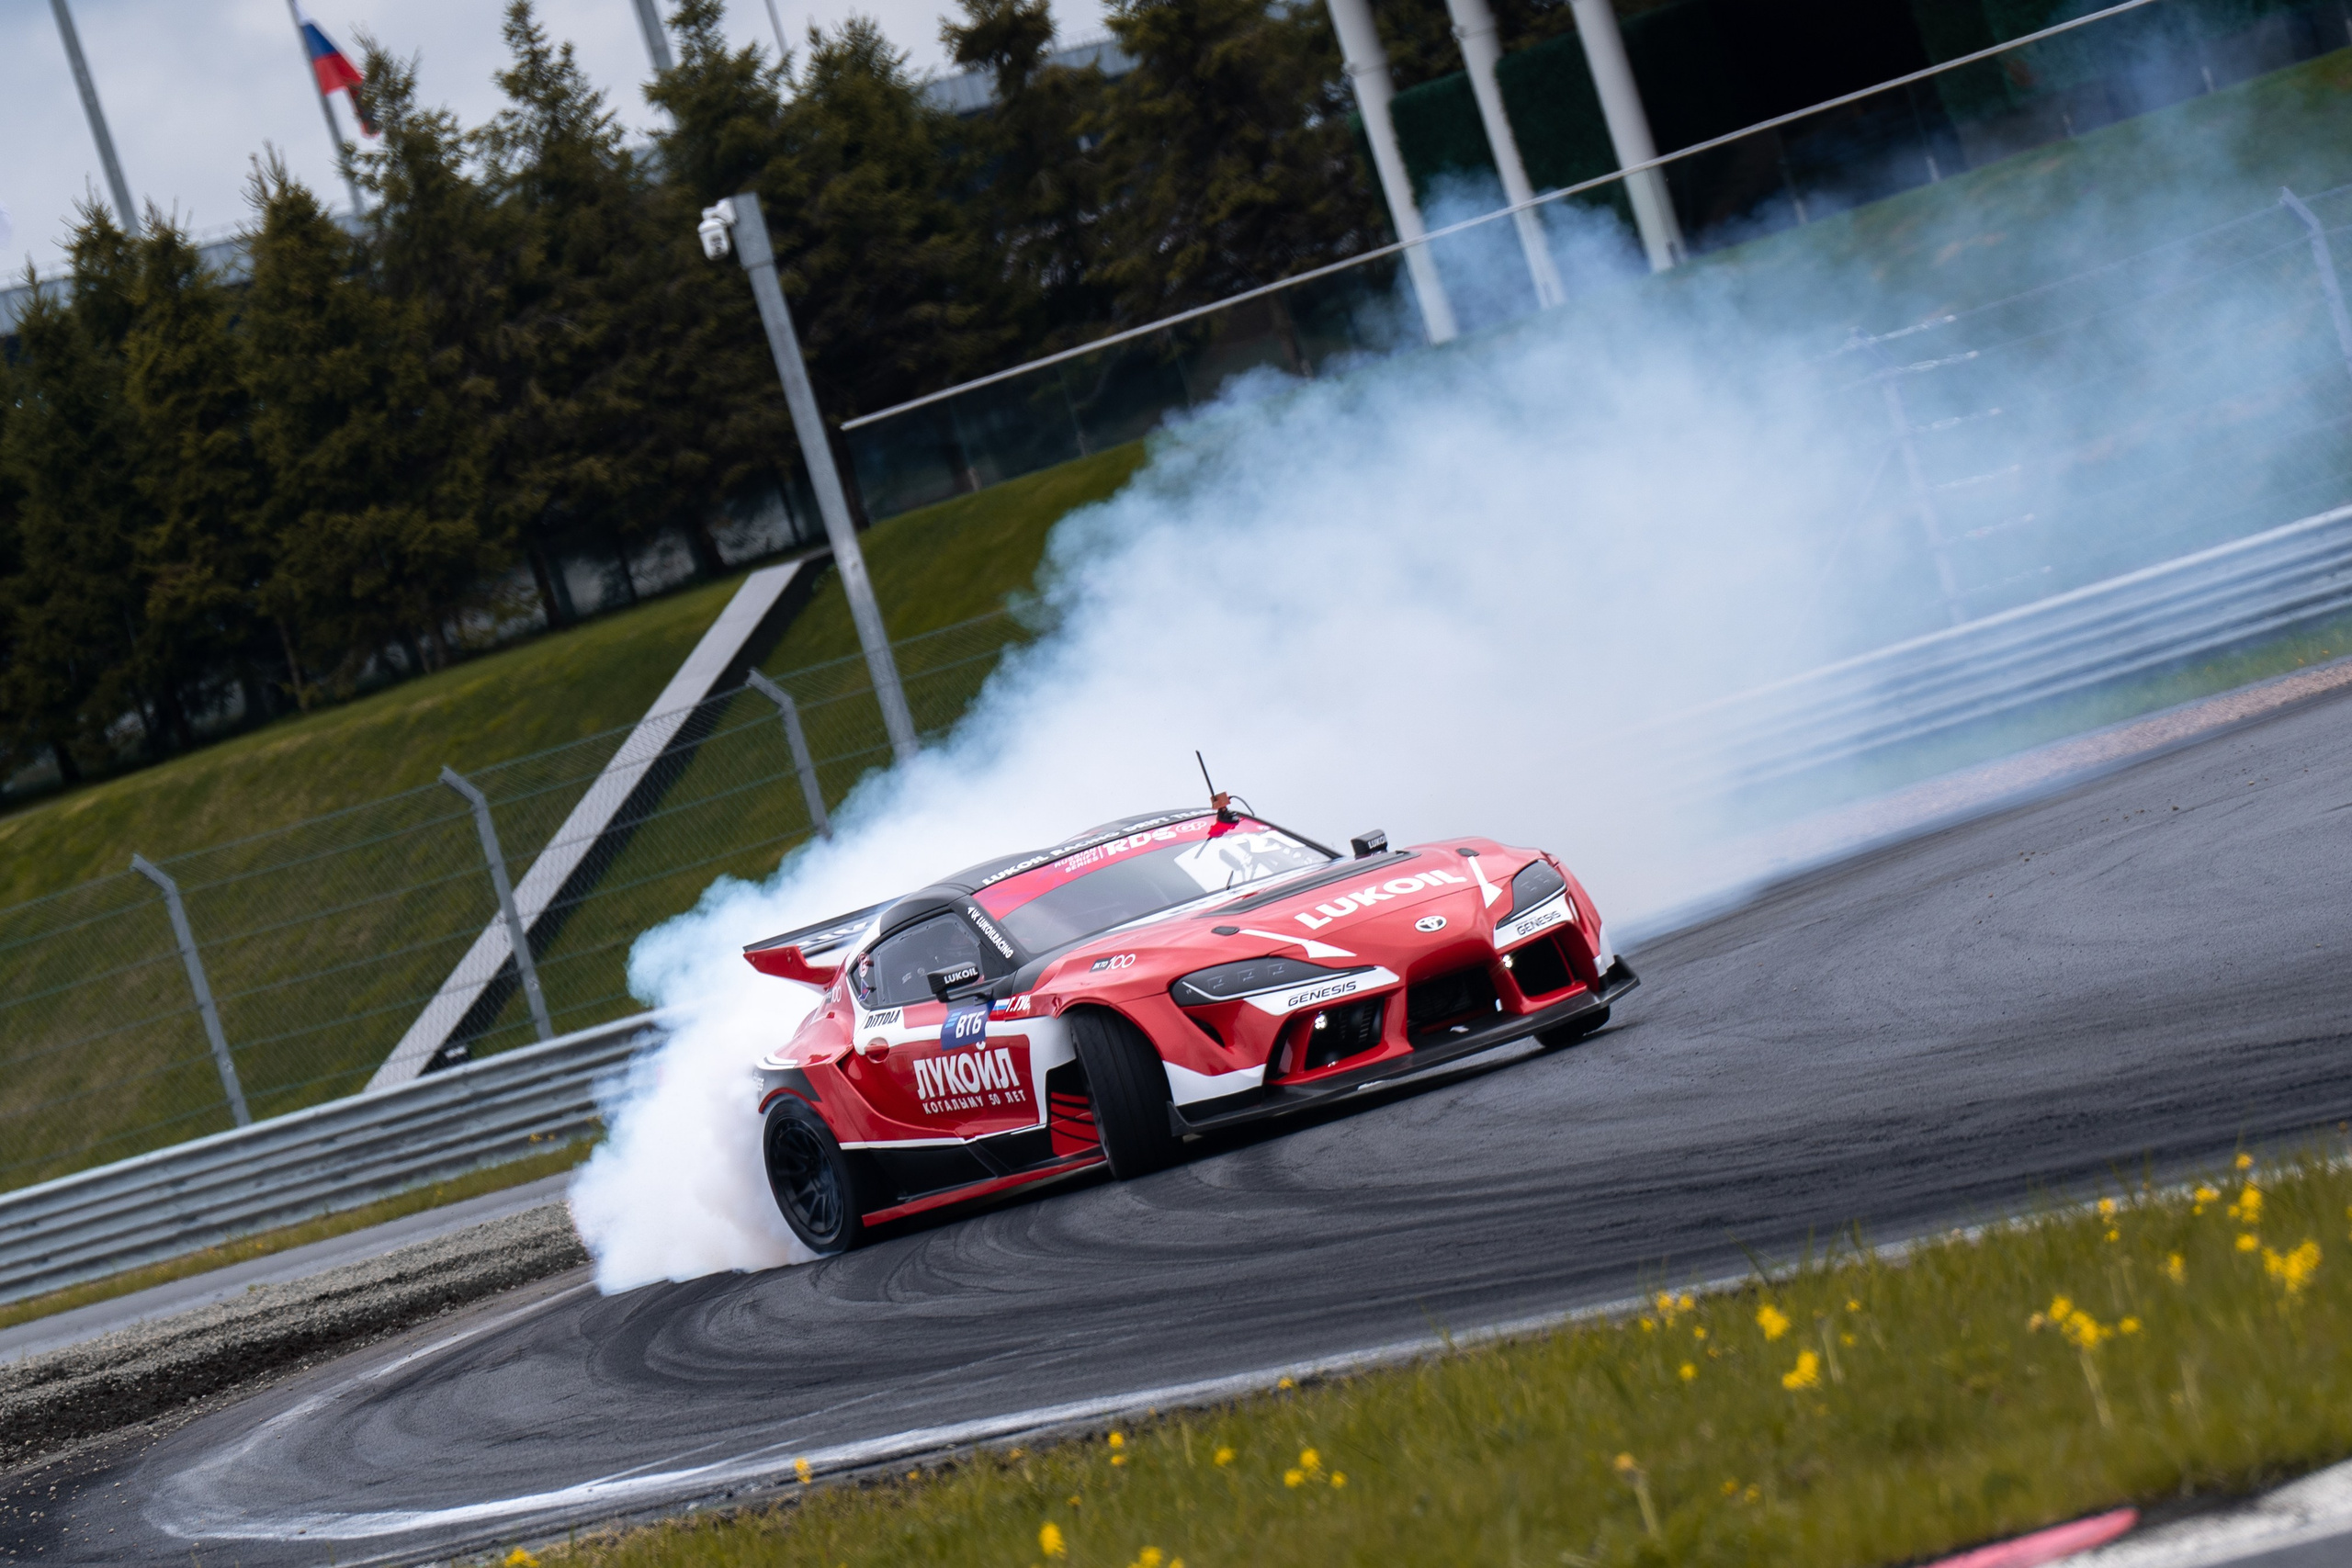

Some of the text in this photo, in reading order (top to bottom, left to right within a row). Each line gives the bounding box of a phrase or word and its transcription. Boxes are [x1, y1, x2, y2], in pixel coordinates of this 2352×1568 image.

[981, 856, 1050, 886] LUKOIL
[1050, 831, 1120, 856] RACING
[1122, 817, 1170, 832] DRIFT
[1102, 826, 1177, 856] RDS
[1054, 846, 1097, 868] RUSSIAN
[1065, 856, 1099, 873] SERIES
[1069, 851, 1097, 866] DRIFT
[1294, 869, 1468, 931] LUKOIL
[1517, 910, 1562, 936] GENESIS
[976, 916, 1013, 959] LUKOILRACING
[1105, 953, 1136, 970] 100
[944, 967, 978, 984] LUKOIL
[1288, 980, 1357, 1007] GENESIS
[956, 1010, 986, 1039] ВТБ
[912, 1041, 1020, 1100] ЛУКОЙЛ
[922, 1089, 1026, 1114] КОГАЛЫМУ 50 ЛЕТ
